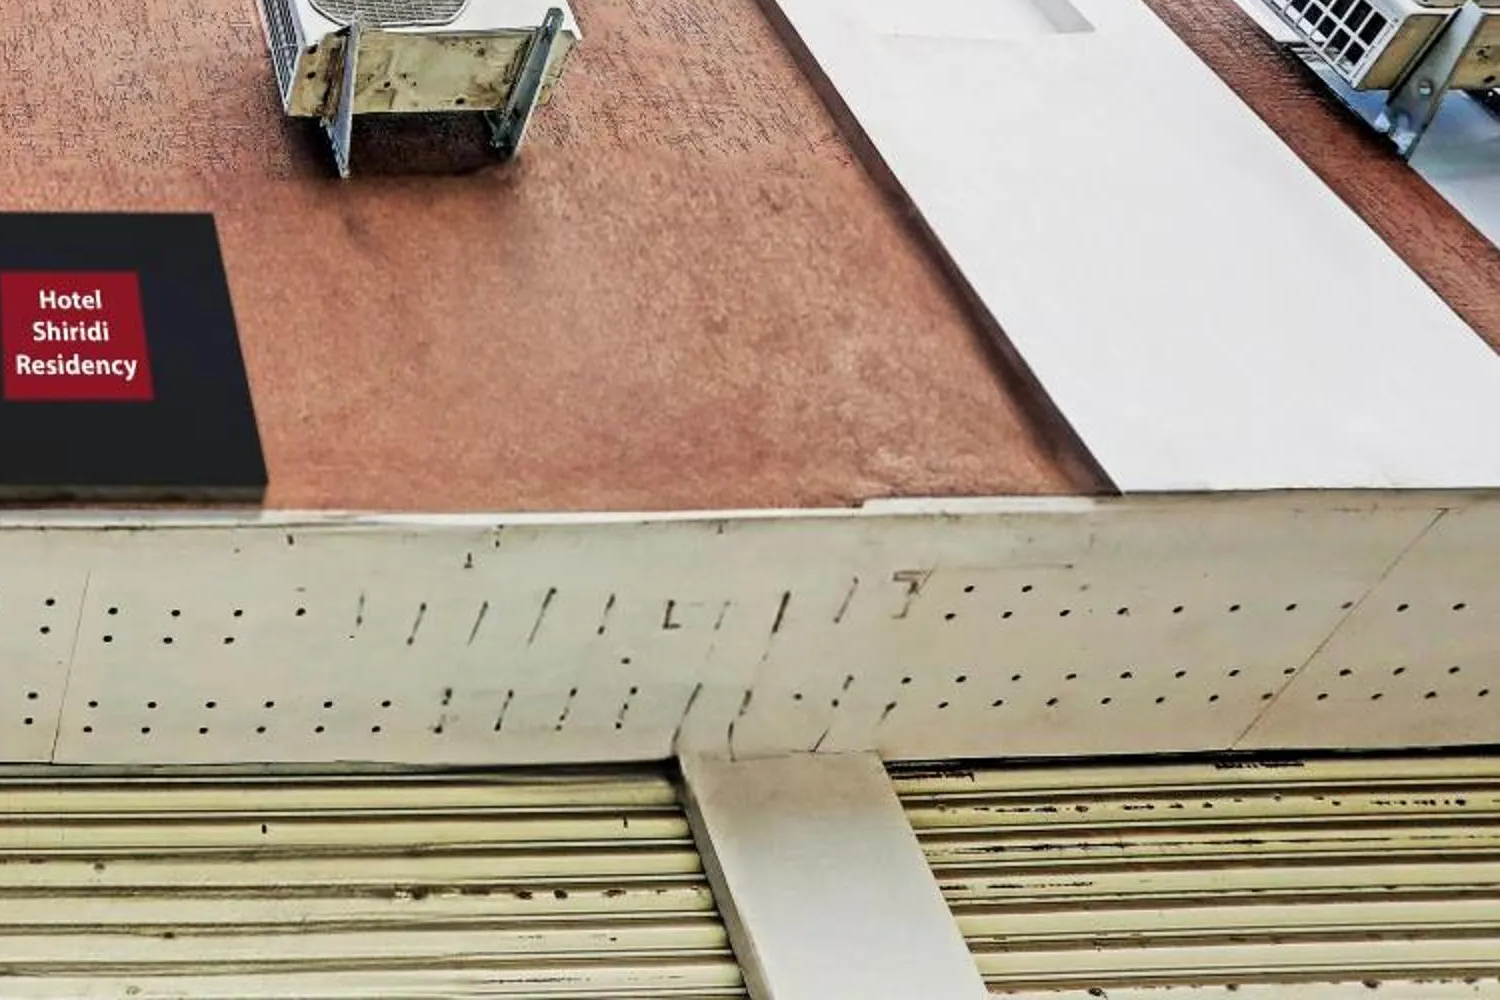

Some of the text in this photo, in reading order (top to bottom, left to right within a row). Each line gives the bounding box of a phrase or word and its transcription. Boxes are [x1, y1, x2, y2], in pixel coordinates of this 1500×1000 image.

[39, 289, 102, 310] Hotel
[32, 320, 110, 342] Shiridi
[15, 353, 138, 382] Residency
